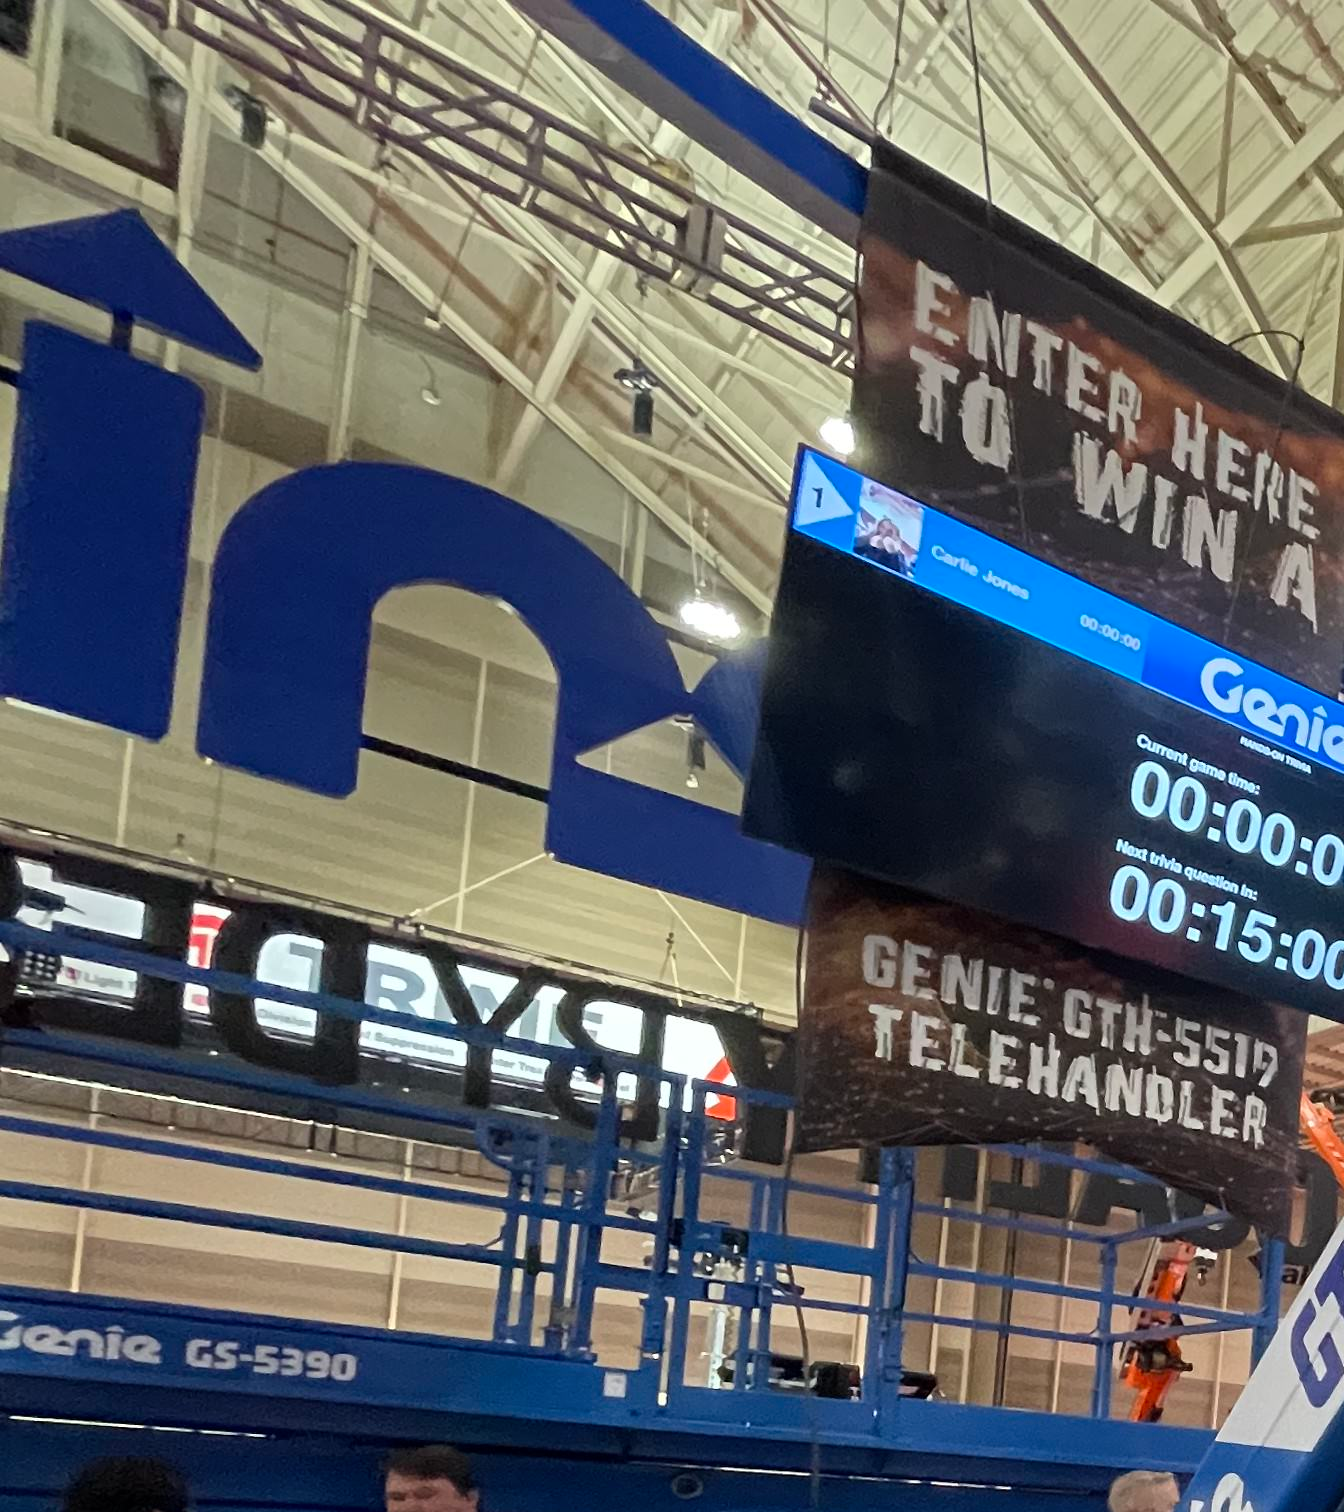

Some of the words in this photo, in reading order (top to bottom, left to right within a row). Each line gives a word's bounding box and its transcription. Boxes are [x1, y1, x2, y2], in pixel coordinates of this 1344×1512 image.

[912, 259, 1142, 446] ENTER
[1172, 402, 1322, 541] HERE
[812, 487, 824, 508] 1
[909, 346, 1014, 473] TO
[1071, 430, 1238, 582] WIN
[1270, 541, 1319, 634] A
[982, 570, 1030, 600] Jones
[1080, 614, 1142, 651] 00:00:00
[1136, 733, 1188, 767] Current
[1188, 757, 1227, 783] game
[1227, 771, 1260, 795] time:
[1115, 838, 1149, 862] Next
[1149, 851, 1182, 874] trivia
[1183, 859, 1240, 894] question
[1241, 884, 1258, 901] in:
[862, 934, 1040, 1026] GENIE
[868, 1004, 1268, 1149] TELEHANDLER
[186, 1339, 358, 1382] GS-5390
